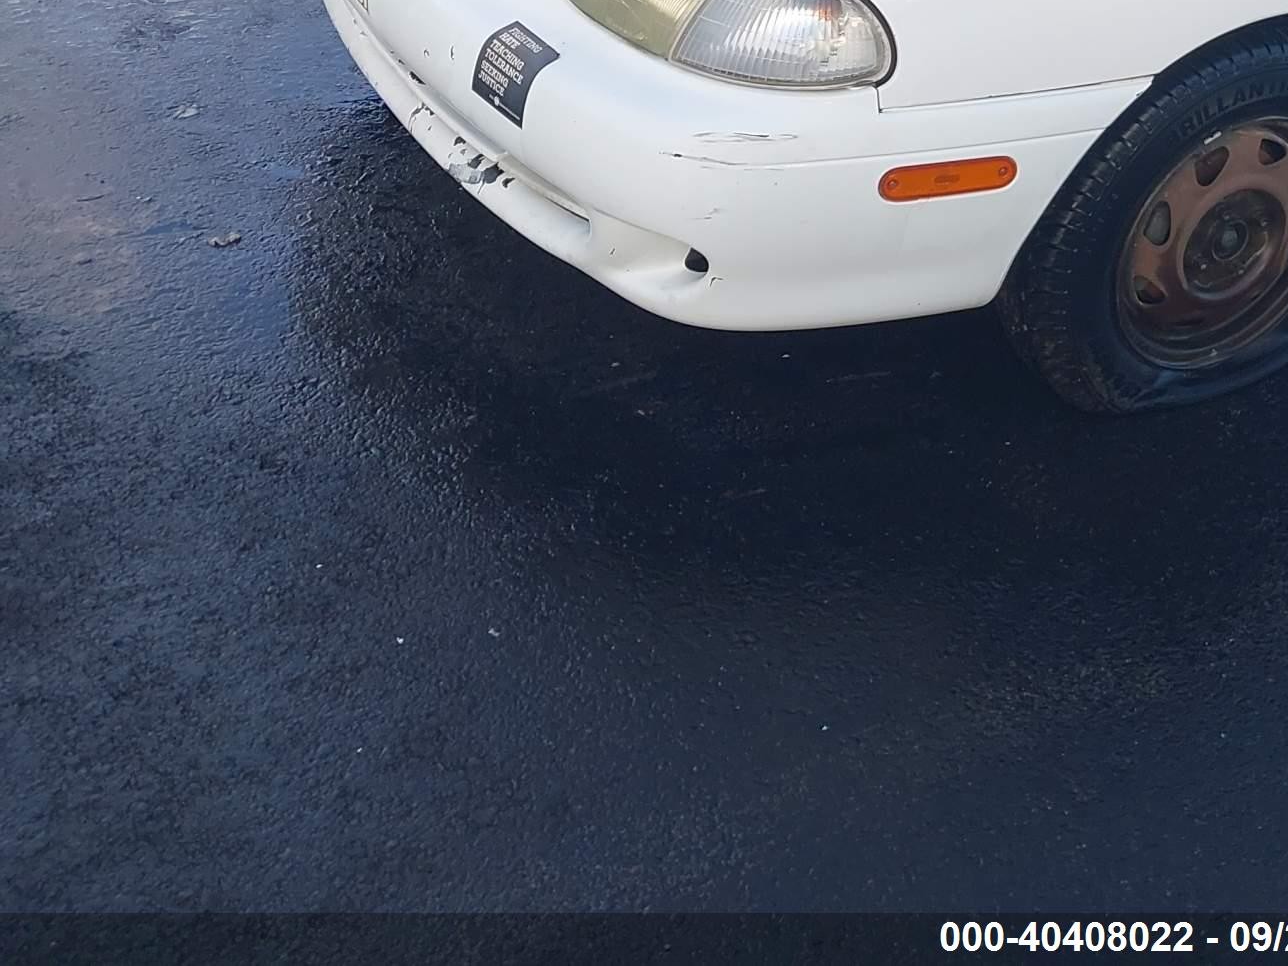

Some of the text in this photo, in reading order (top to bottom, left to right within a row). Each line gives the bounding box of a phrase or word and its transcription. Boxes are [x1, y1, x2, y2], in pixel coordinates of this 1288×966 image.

[499, 32, 521, 49] HATE
[509, 27, 543, 53] FIGHTING
[484, 47, 524, 85] TOLERANCE
[490, 39, 524, 71] TEACHING
[478, 70, 504, 96] JUSTICE
[481, 60, 508, 88] SEEKING
